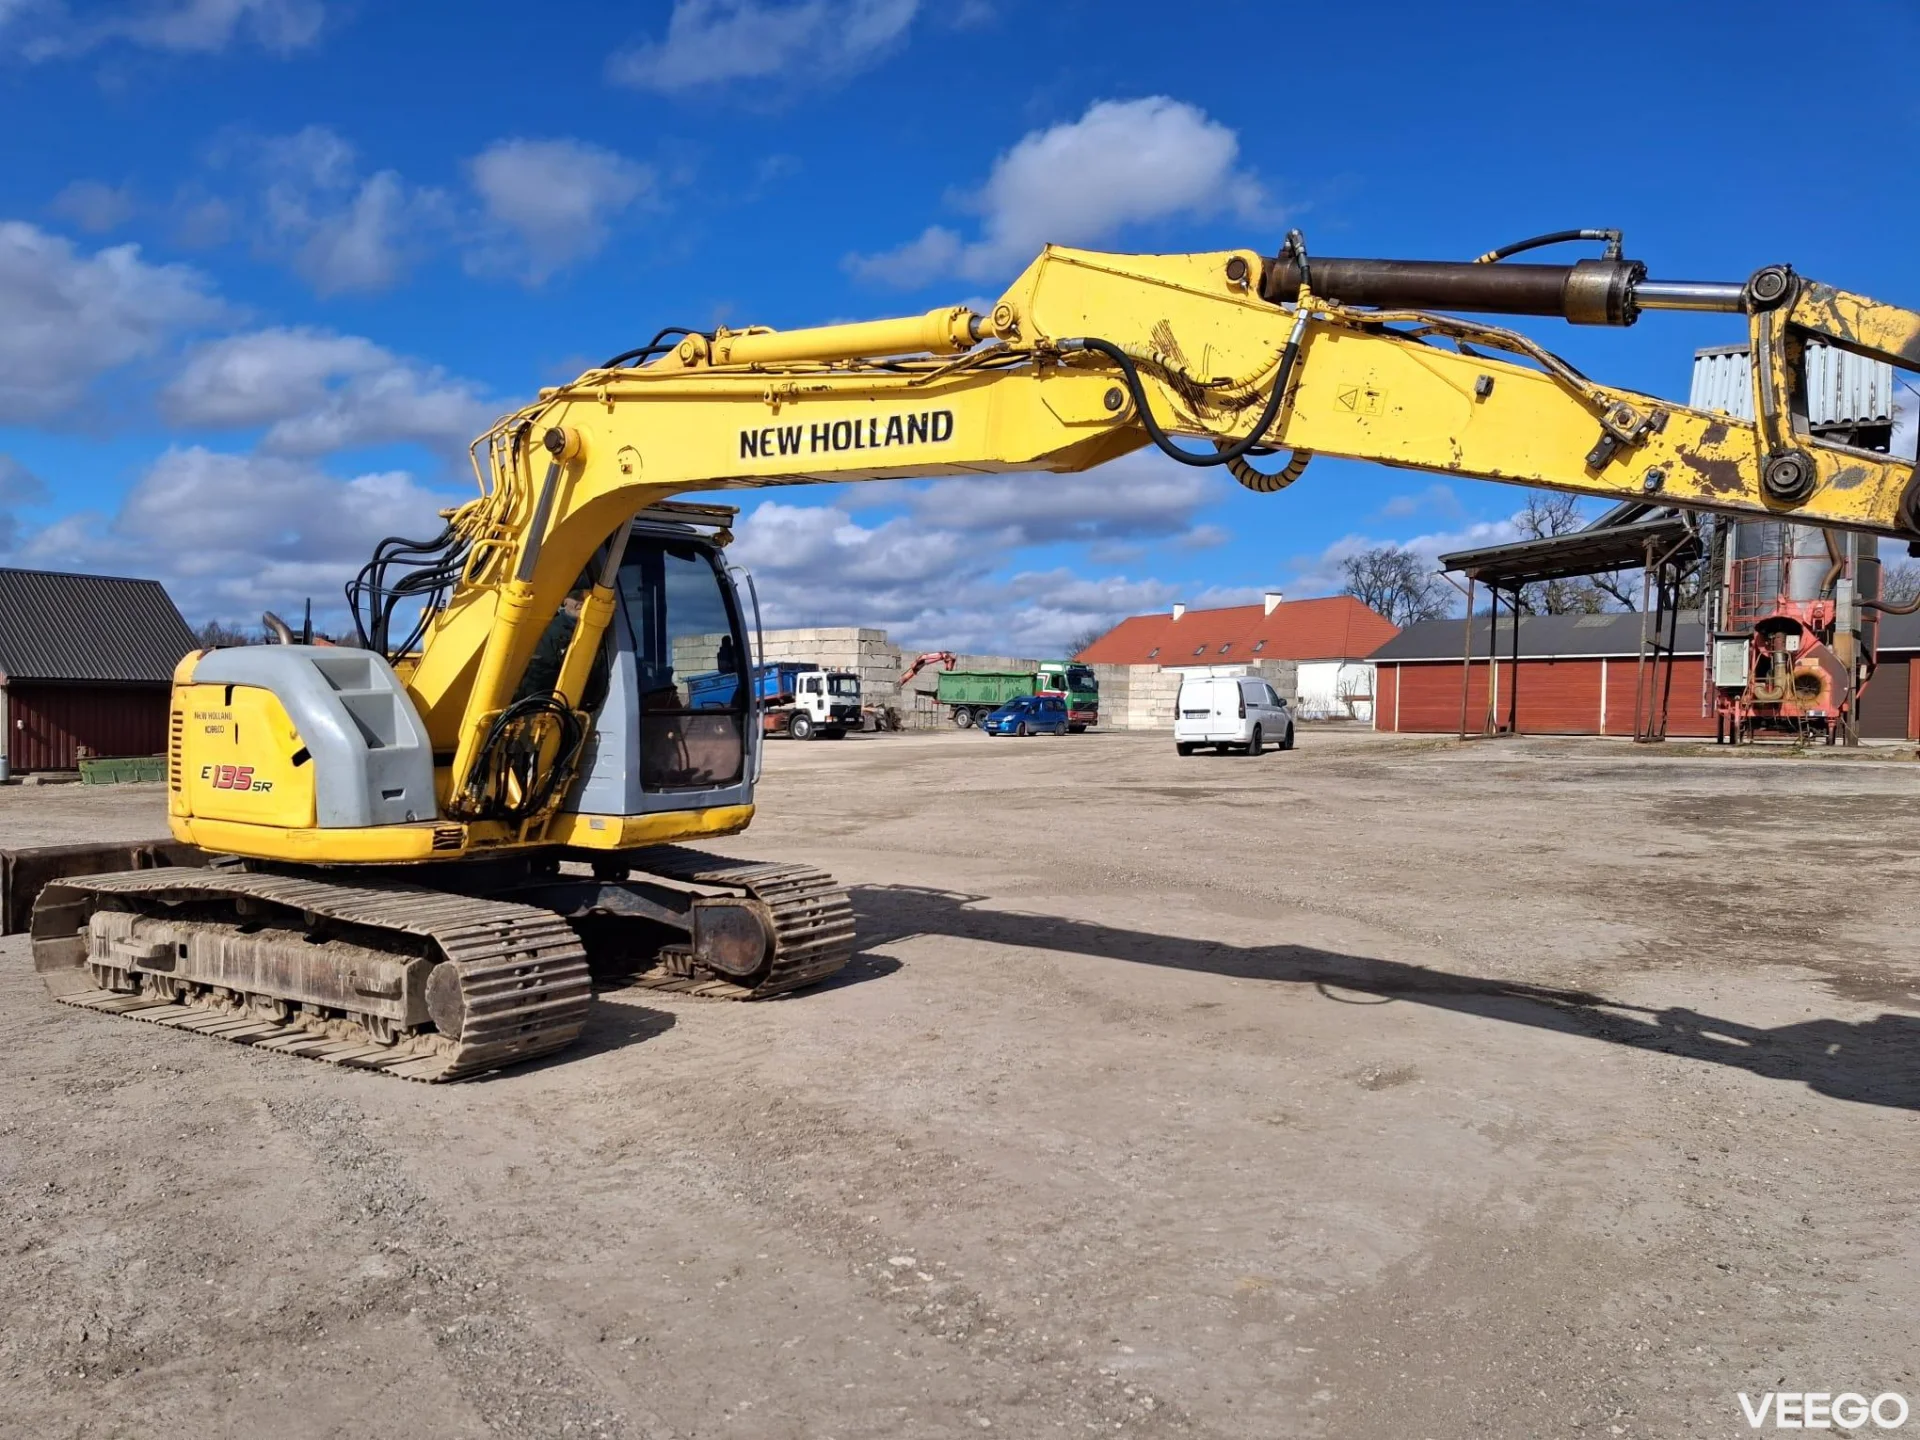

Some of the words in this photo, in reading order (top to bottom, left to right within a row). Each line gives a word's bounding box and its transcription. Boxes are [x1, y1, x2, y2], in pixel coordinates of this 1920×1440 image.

[740, 425, 803, 459] NEW
[811, 410, 954, 453] HOLLAND
[194, 711, 207, 720] NEW
[208, 711, 233, 721] HOLLAND
